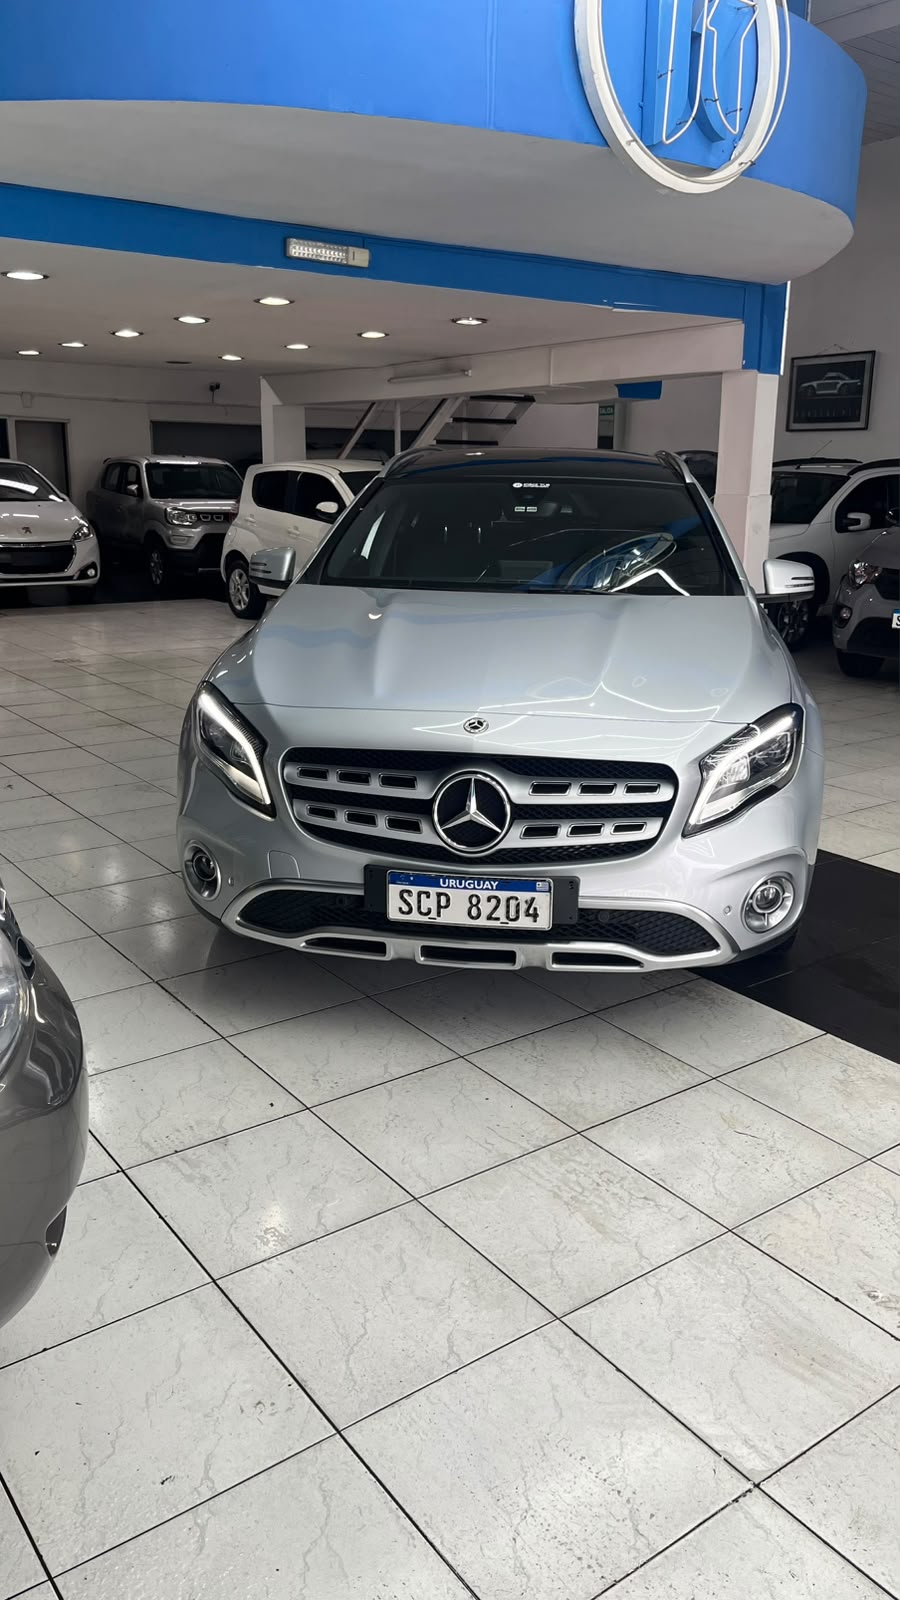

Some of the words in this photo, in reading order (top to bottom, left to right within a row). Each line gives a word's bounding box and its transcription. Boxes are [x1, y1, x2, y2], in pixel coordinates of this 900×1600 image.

[439, 878, 499, 890] URUGUAY
[398, 889, 451, 918] SCP
[467, 893, 540, 923] 8204
